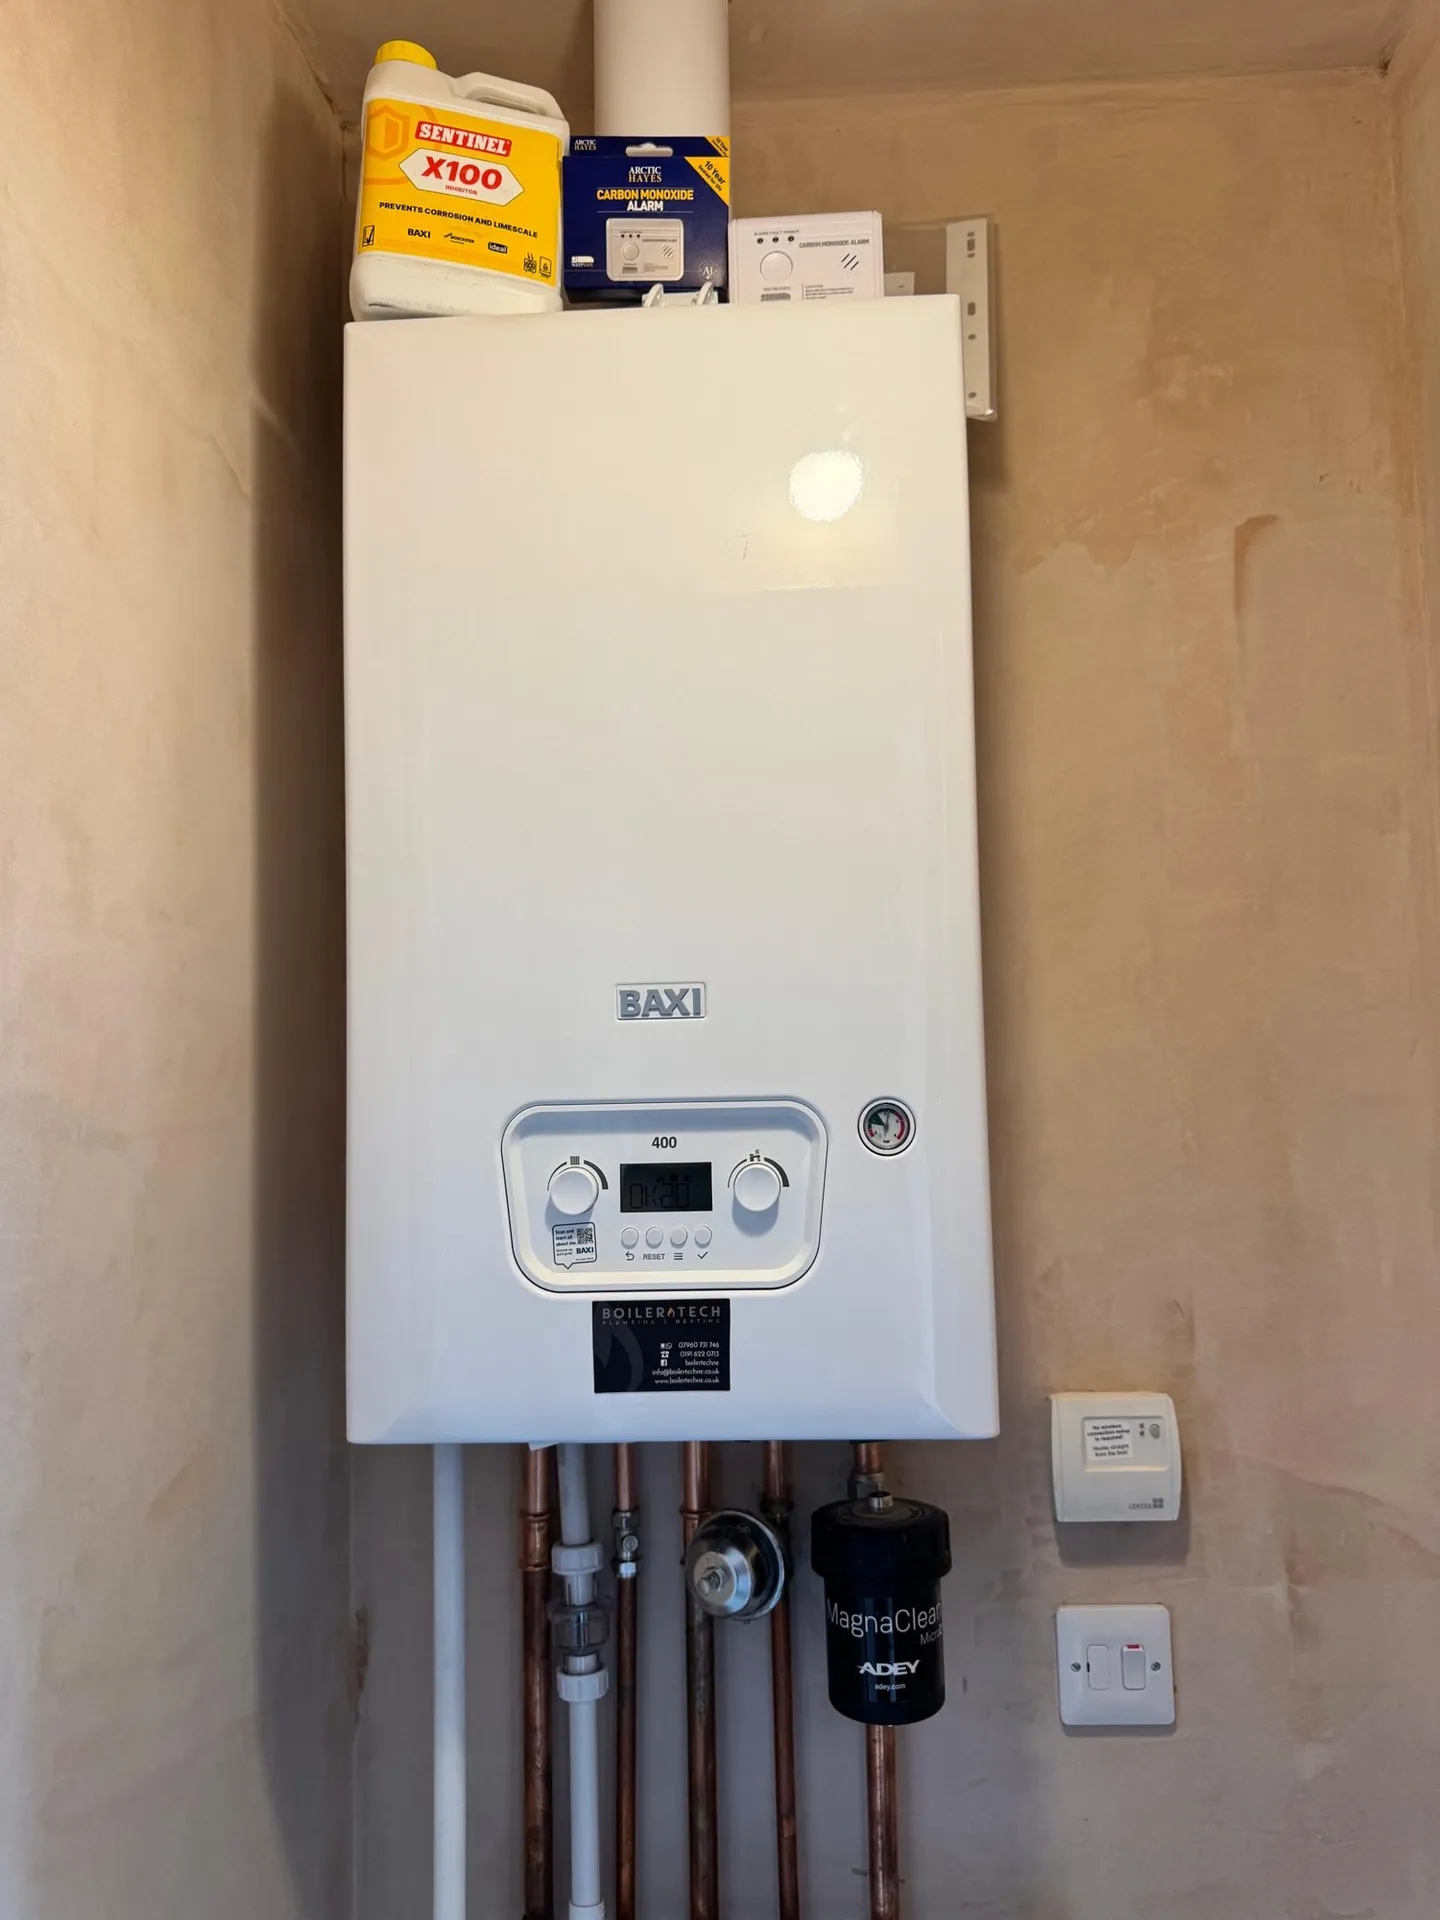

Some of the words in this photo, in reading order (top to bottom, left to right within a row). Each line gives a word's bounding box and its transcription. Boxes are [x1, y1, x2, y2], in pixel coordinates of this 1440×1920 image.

[419, 124, 508, 155] SENTINEL
[421, 156, 502, 190] X100
[628, 166, 662, 174] ARCTIC
[705, 161, 713, 170] 10
[712, 168, 726, 184] Year
[628, 174, 662, 182] HAYES
[445, 184, 478, 195] INHIBITOR
[596, 189, 639, 200] CARBON
[640, 189, 694, 200] MONOXIDE
[627, 200, 664, 211] ALARM
[380, 202, 423, 214] PREVENTS
[425, 207, 474, 223] CORROSION
[475, 217, 492, 226] AND
[494, 221, 538, 238] LIMESCALE
[407, 228, 431, 238] BAXI
[489, 243, 507, 253] ideal
[620, 988, 701, 1017] BAXI
[652, 1136, 677, 1148] 400
[652, 1368, 719, 1376] info@boilertechne.co.uk
[857, 1660, 920, 1676] ADEY
